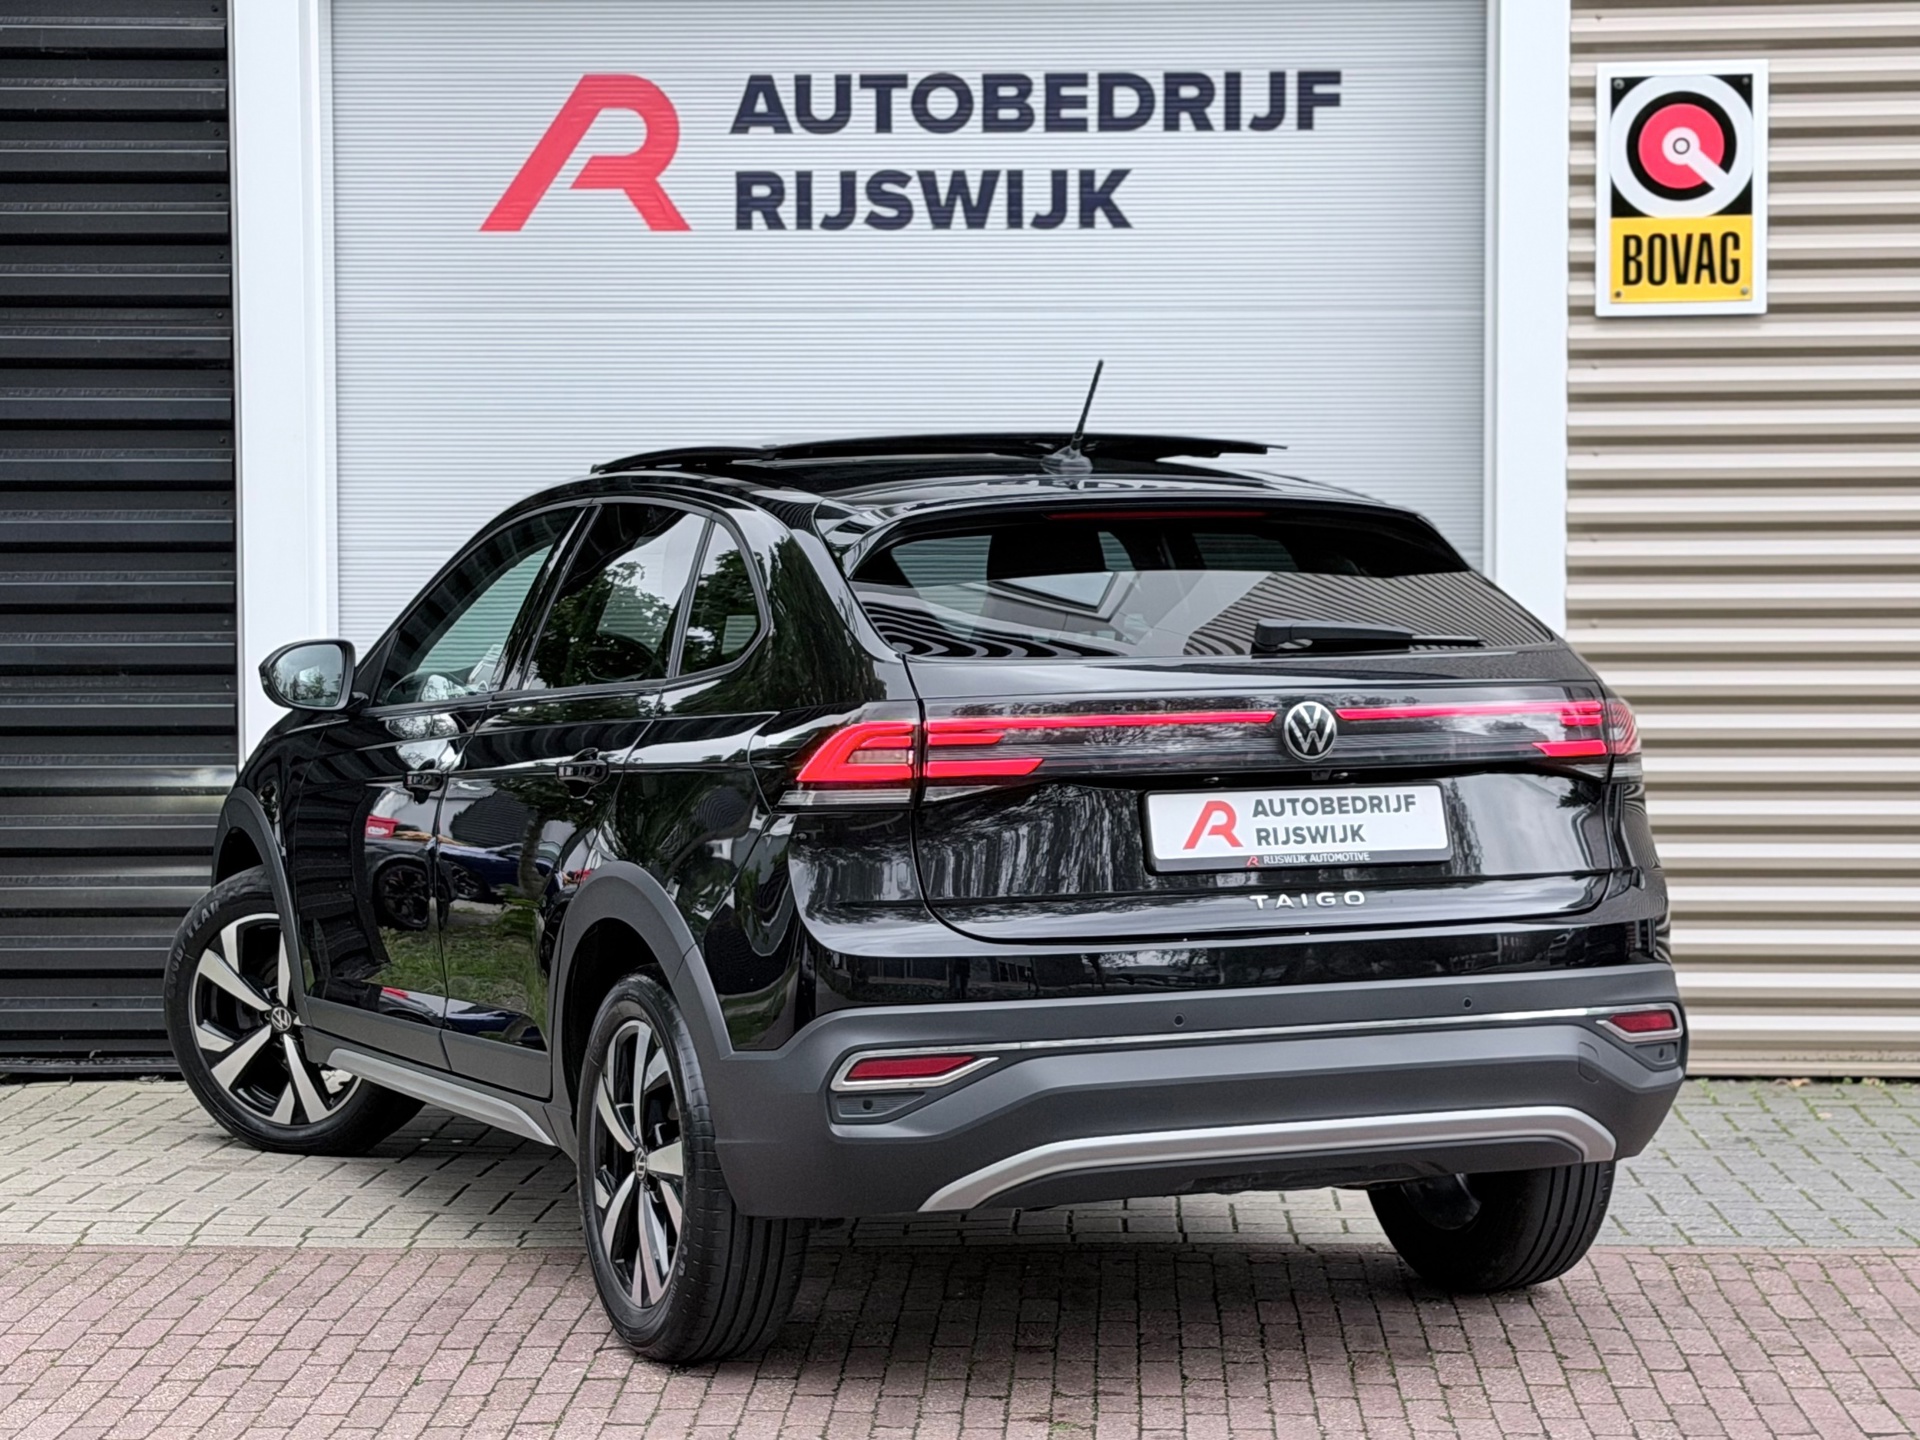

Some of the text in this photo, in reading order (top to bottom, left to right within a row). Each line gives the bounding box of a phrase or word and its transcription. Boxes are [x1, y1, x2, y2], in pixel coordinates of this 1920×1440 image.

[729, 70, 1343, 135] AUTOBEDRIJF
[735, 168, 1134, 231] RIJSWIJK
[1622, 231, 1741, 286] BOVAG
[1252, 794, 1416, 818] AUTOBEDRIJF
[1255, 824, 1366, 846] RIJSWIJK
[1263, 854, 1308, 865] RIJSWIJK
[1309, 851, 1371, 863] AUTOMOTIVE
[1249, 890, 1366, 910] TAIGO
